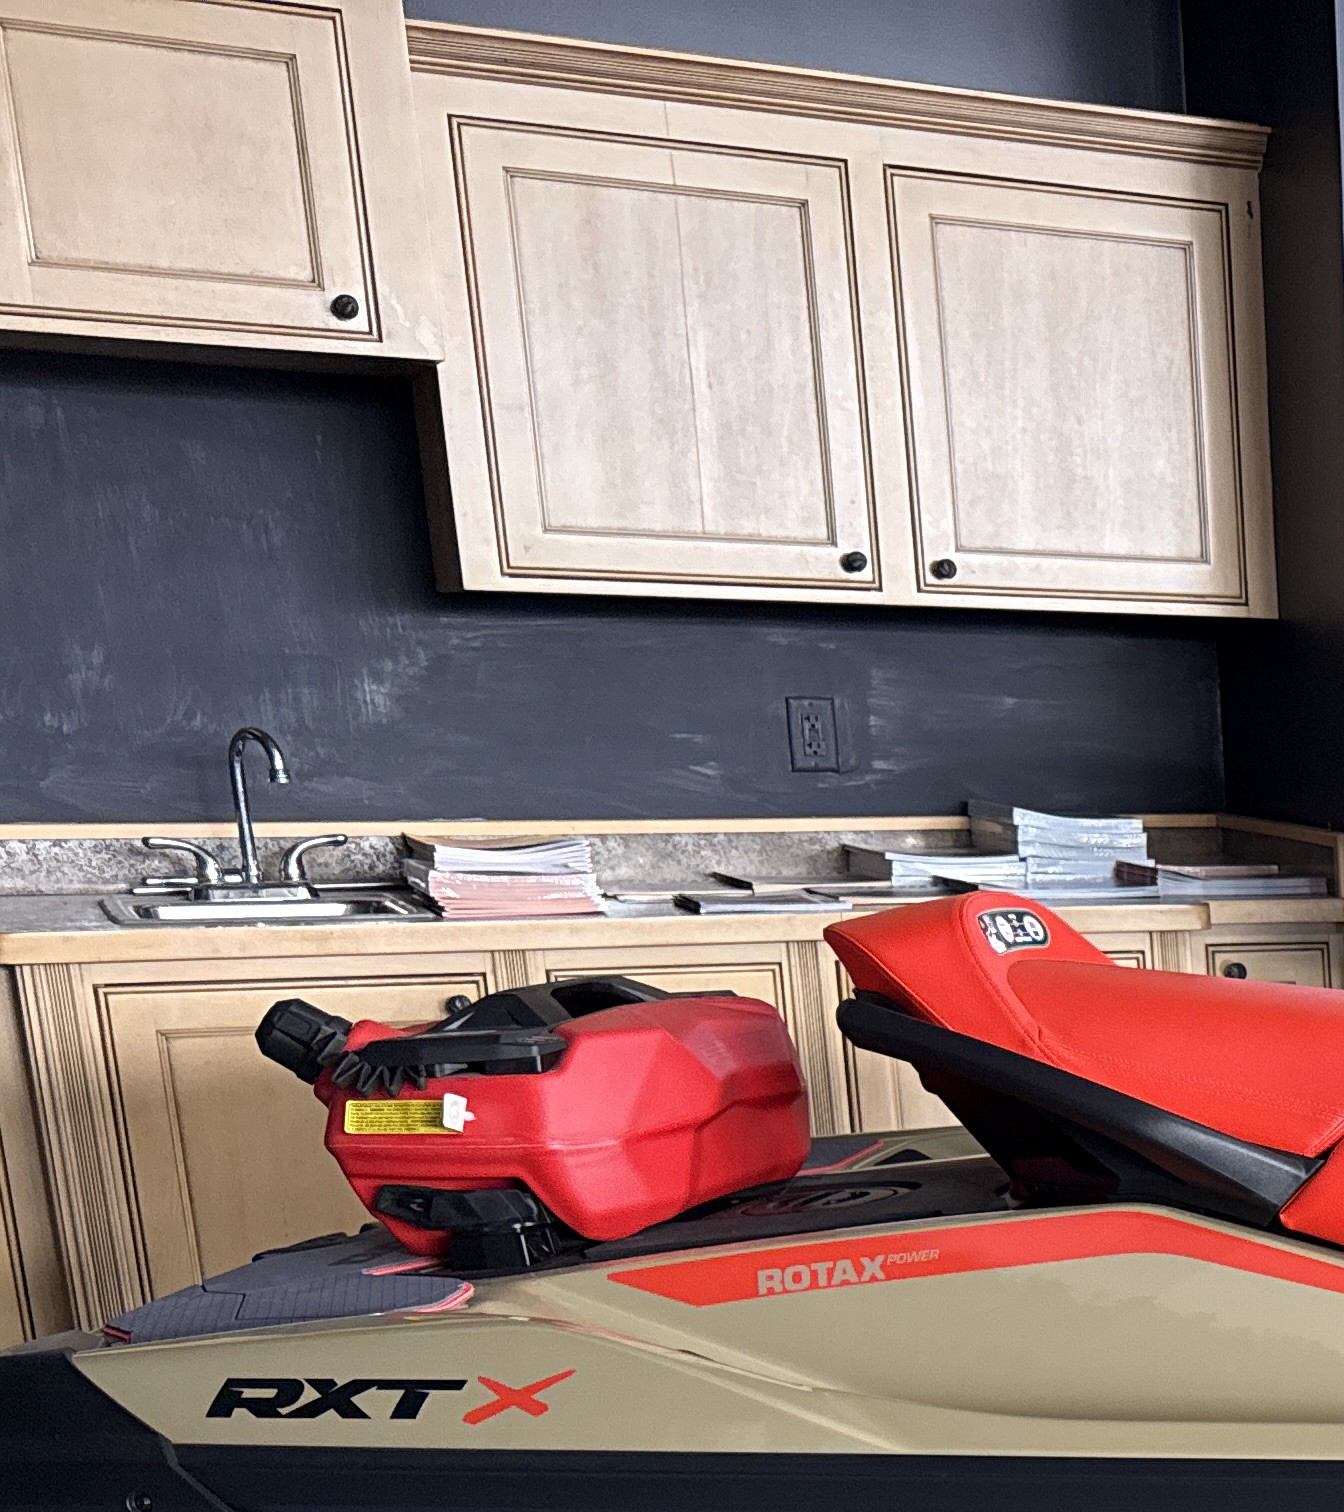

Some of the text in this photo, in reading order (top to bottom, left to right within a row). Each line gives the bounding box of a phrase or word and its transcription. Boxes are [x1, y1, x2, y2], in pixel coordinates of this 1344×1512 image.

[757, 1249, 940, 1295] ROTAX POWER
[205, 1377, 467, 1420] RXT
